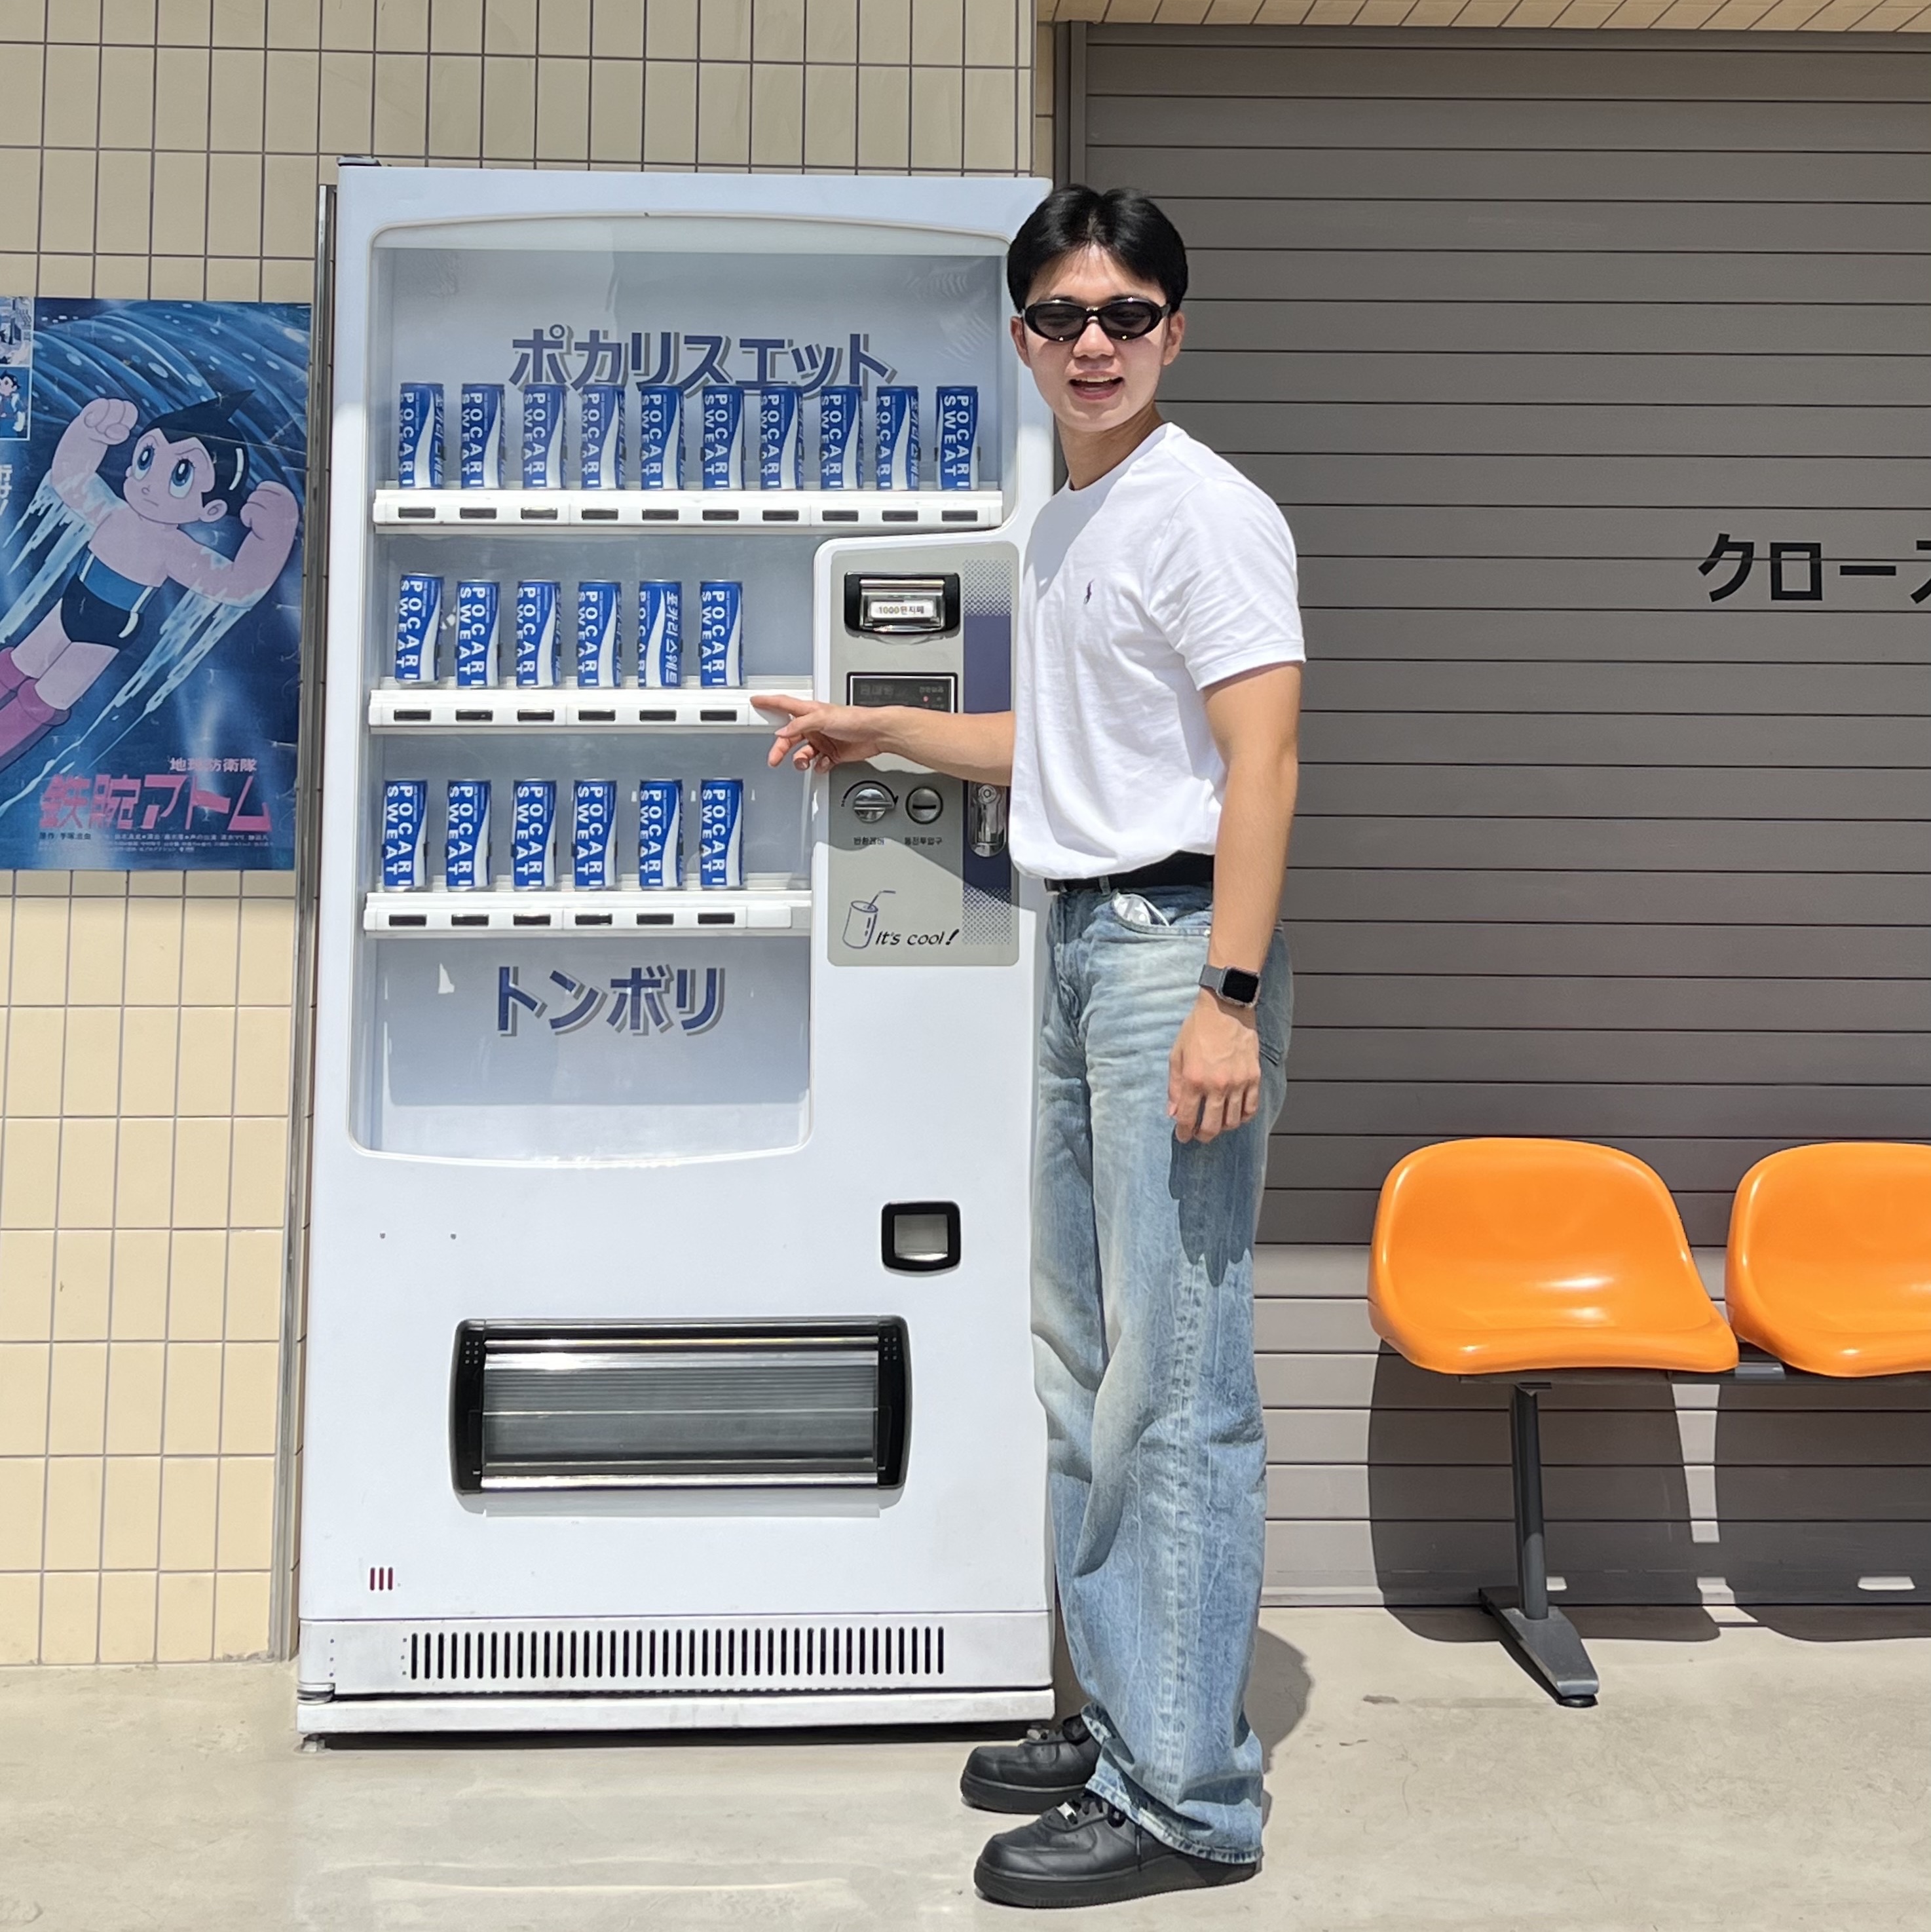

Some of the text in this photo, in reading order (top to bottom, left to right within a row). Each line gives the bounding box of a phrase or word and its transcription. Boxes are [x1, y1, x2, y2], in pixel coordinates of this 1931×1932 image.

[509, 324, 897, 399] ポカリスエット
[402, 393, 414, 484] POCARI
[469, 393, 483, 484] POCARI
[533, 393, 546, 483] POCARI
[588, 393, 599, 484] POCARI
[649, 394, 662, 485] POCARI
[705, 394, 715, 476] SWEAT
[715, 394, 728, 485] POCARI
[768, 395, 779, 485] POCARI
[829, 395, 842, 485] POCARI
[880, 396, 891, 487] POCARI
[944, 396, 956, 476] SWEAT
[956, 396, 969, 486] POCARI
[396, 580, 409, 668] SWEAT
[404, 580, 423, 678] POCARI
[459, 587, 472, 675] SWEAT
[471, 587, 485, 685] POCARI
[523, 587, 536, 684] POCARI
[585, 592, 598, 683] POCARI
[702, 591, 712, 673] SWEAT
[712, 591, 725, 683] POCARI
[39, 774, 272, 831] 鉄腕アトム
[386, 786, 398, 875] SWEAT
[398, 786, 413, 884] POCARI
[447, 786, 459, 875] SWEAT
[458, 786, 473, 884] POCARI
[516, 786, 529, 876] SWEAT
[529, 787, 544, 884] POCARI
[577, 786, 589, 876] SWEAT
[589, 787, 603, 884] POCARI
[640, 790, 649, 873] SWEAT
[648, 790, 662, 883] POCARI
[701, 789, 713, 873] SWEAT
[712, 789, 726, 882] POCARI
[875, 931, 901, 945] It's
[498, 964, 725, 1036] トンボリ
